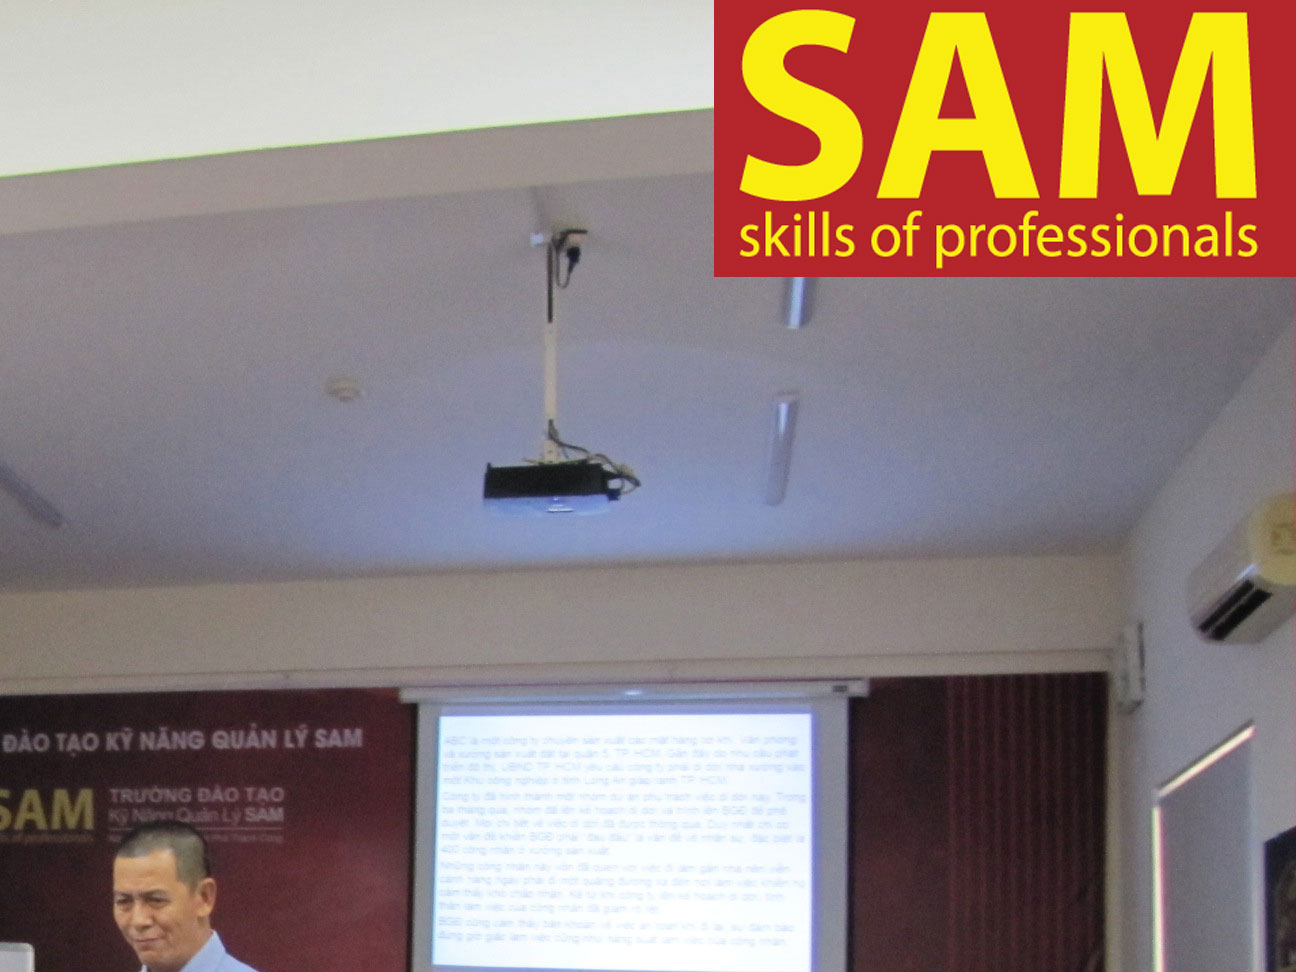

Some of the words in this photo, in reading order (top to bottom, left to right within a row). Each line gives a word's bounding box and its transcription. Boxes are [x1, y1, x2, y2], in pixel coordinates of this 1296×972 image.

[55, 732, 99, 757] TẠO
[314, 728, 363, 748] SAM
[245, 807, 284, 822] SAM
